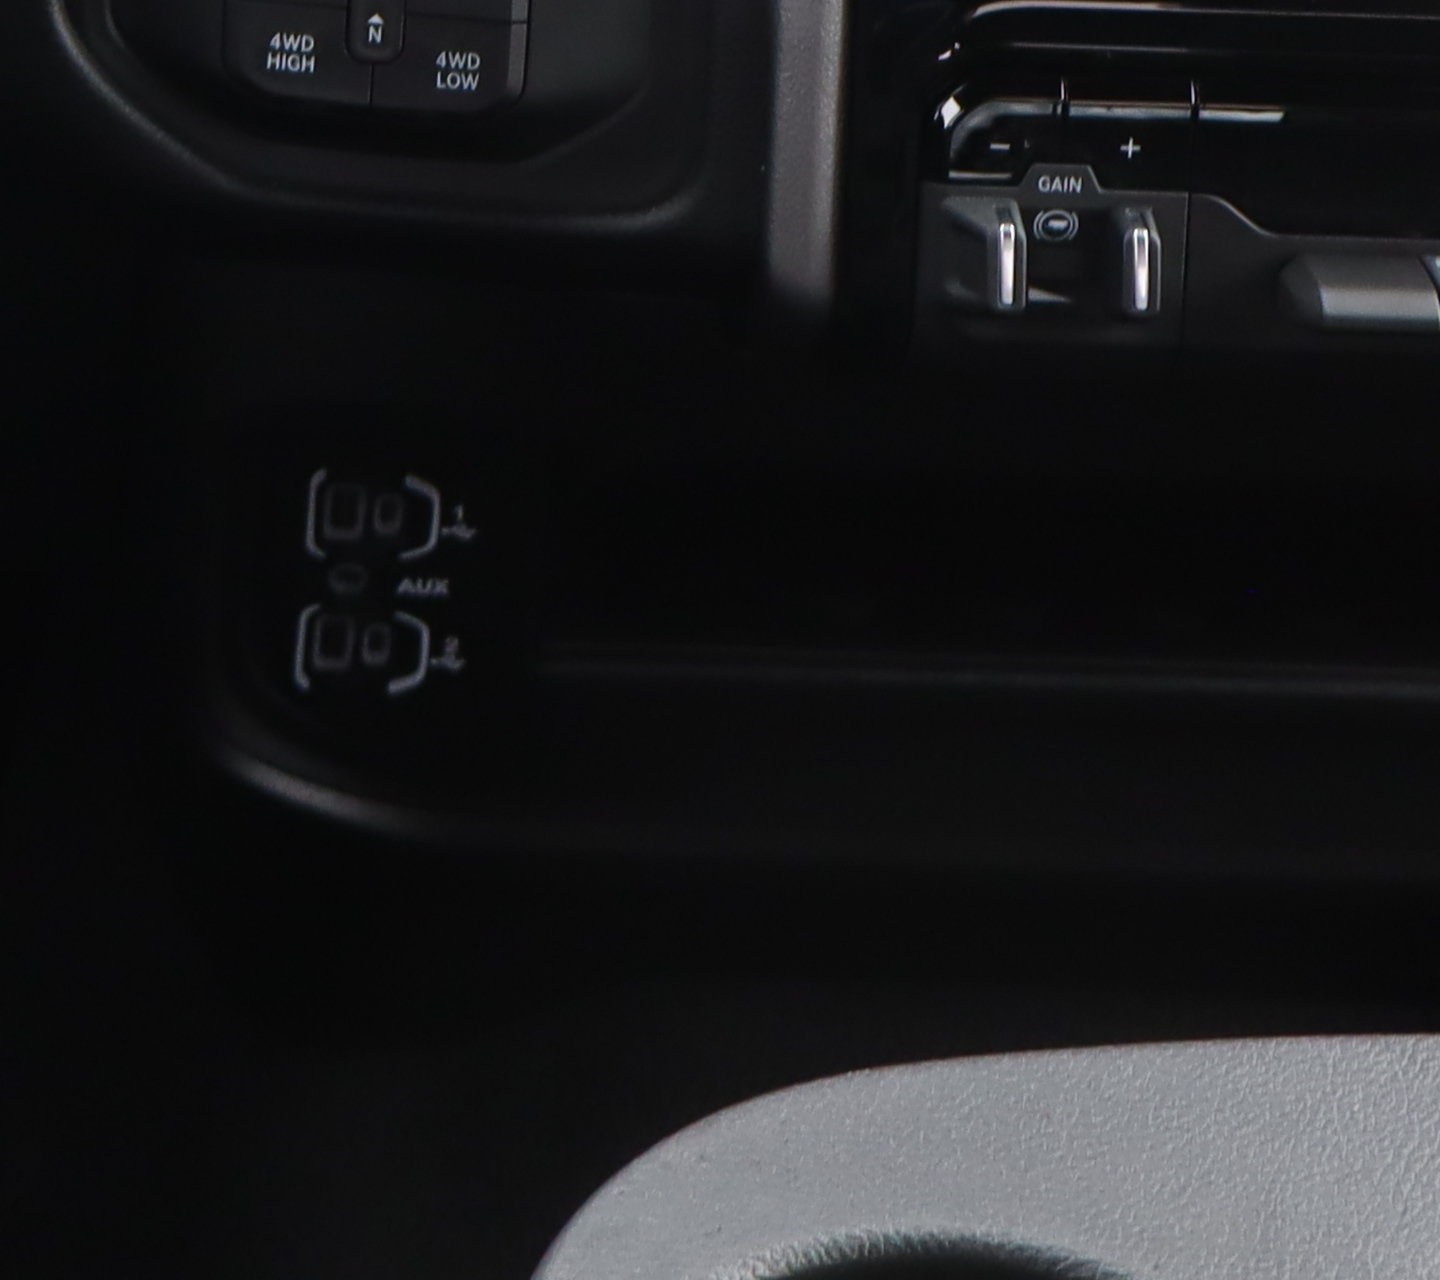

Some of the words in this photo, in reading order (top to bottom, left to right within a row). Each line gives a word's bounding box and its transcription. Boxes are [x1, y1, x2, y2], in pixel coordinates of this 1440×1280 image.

[270, 32, 315, 52] 4WD
[368, 25, 382, 43] N
[266, 52, 316, 73] HIGH
[435, 51, 481, 70] 4WD
[436, 72, 480, 90] LOW
[1038, 176, 1083, 193] GAIN
[396, 577, 450, 596] AUX
